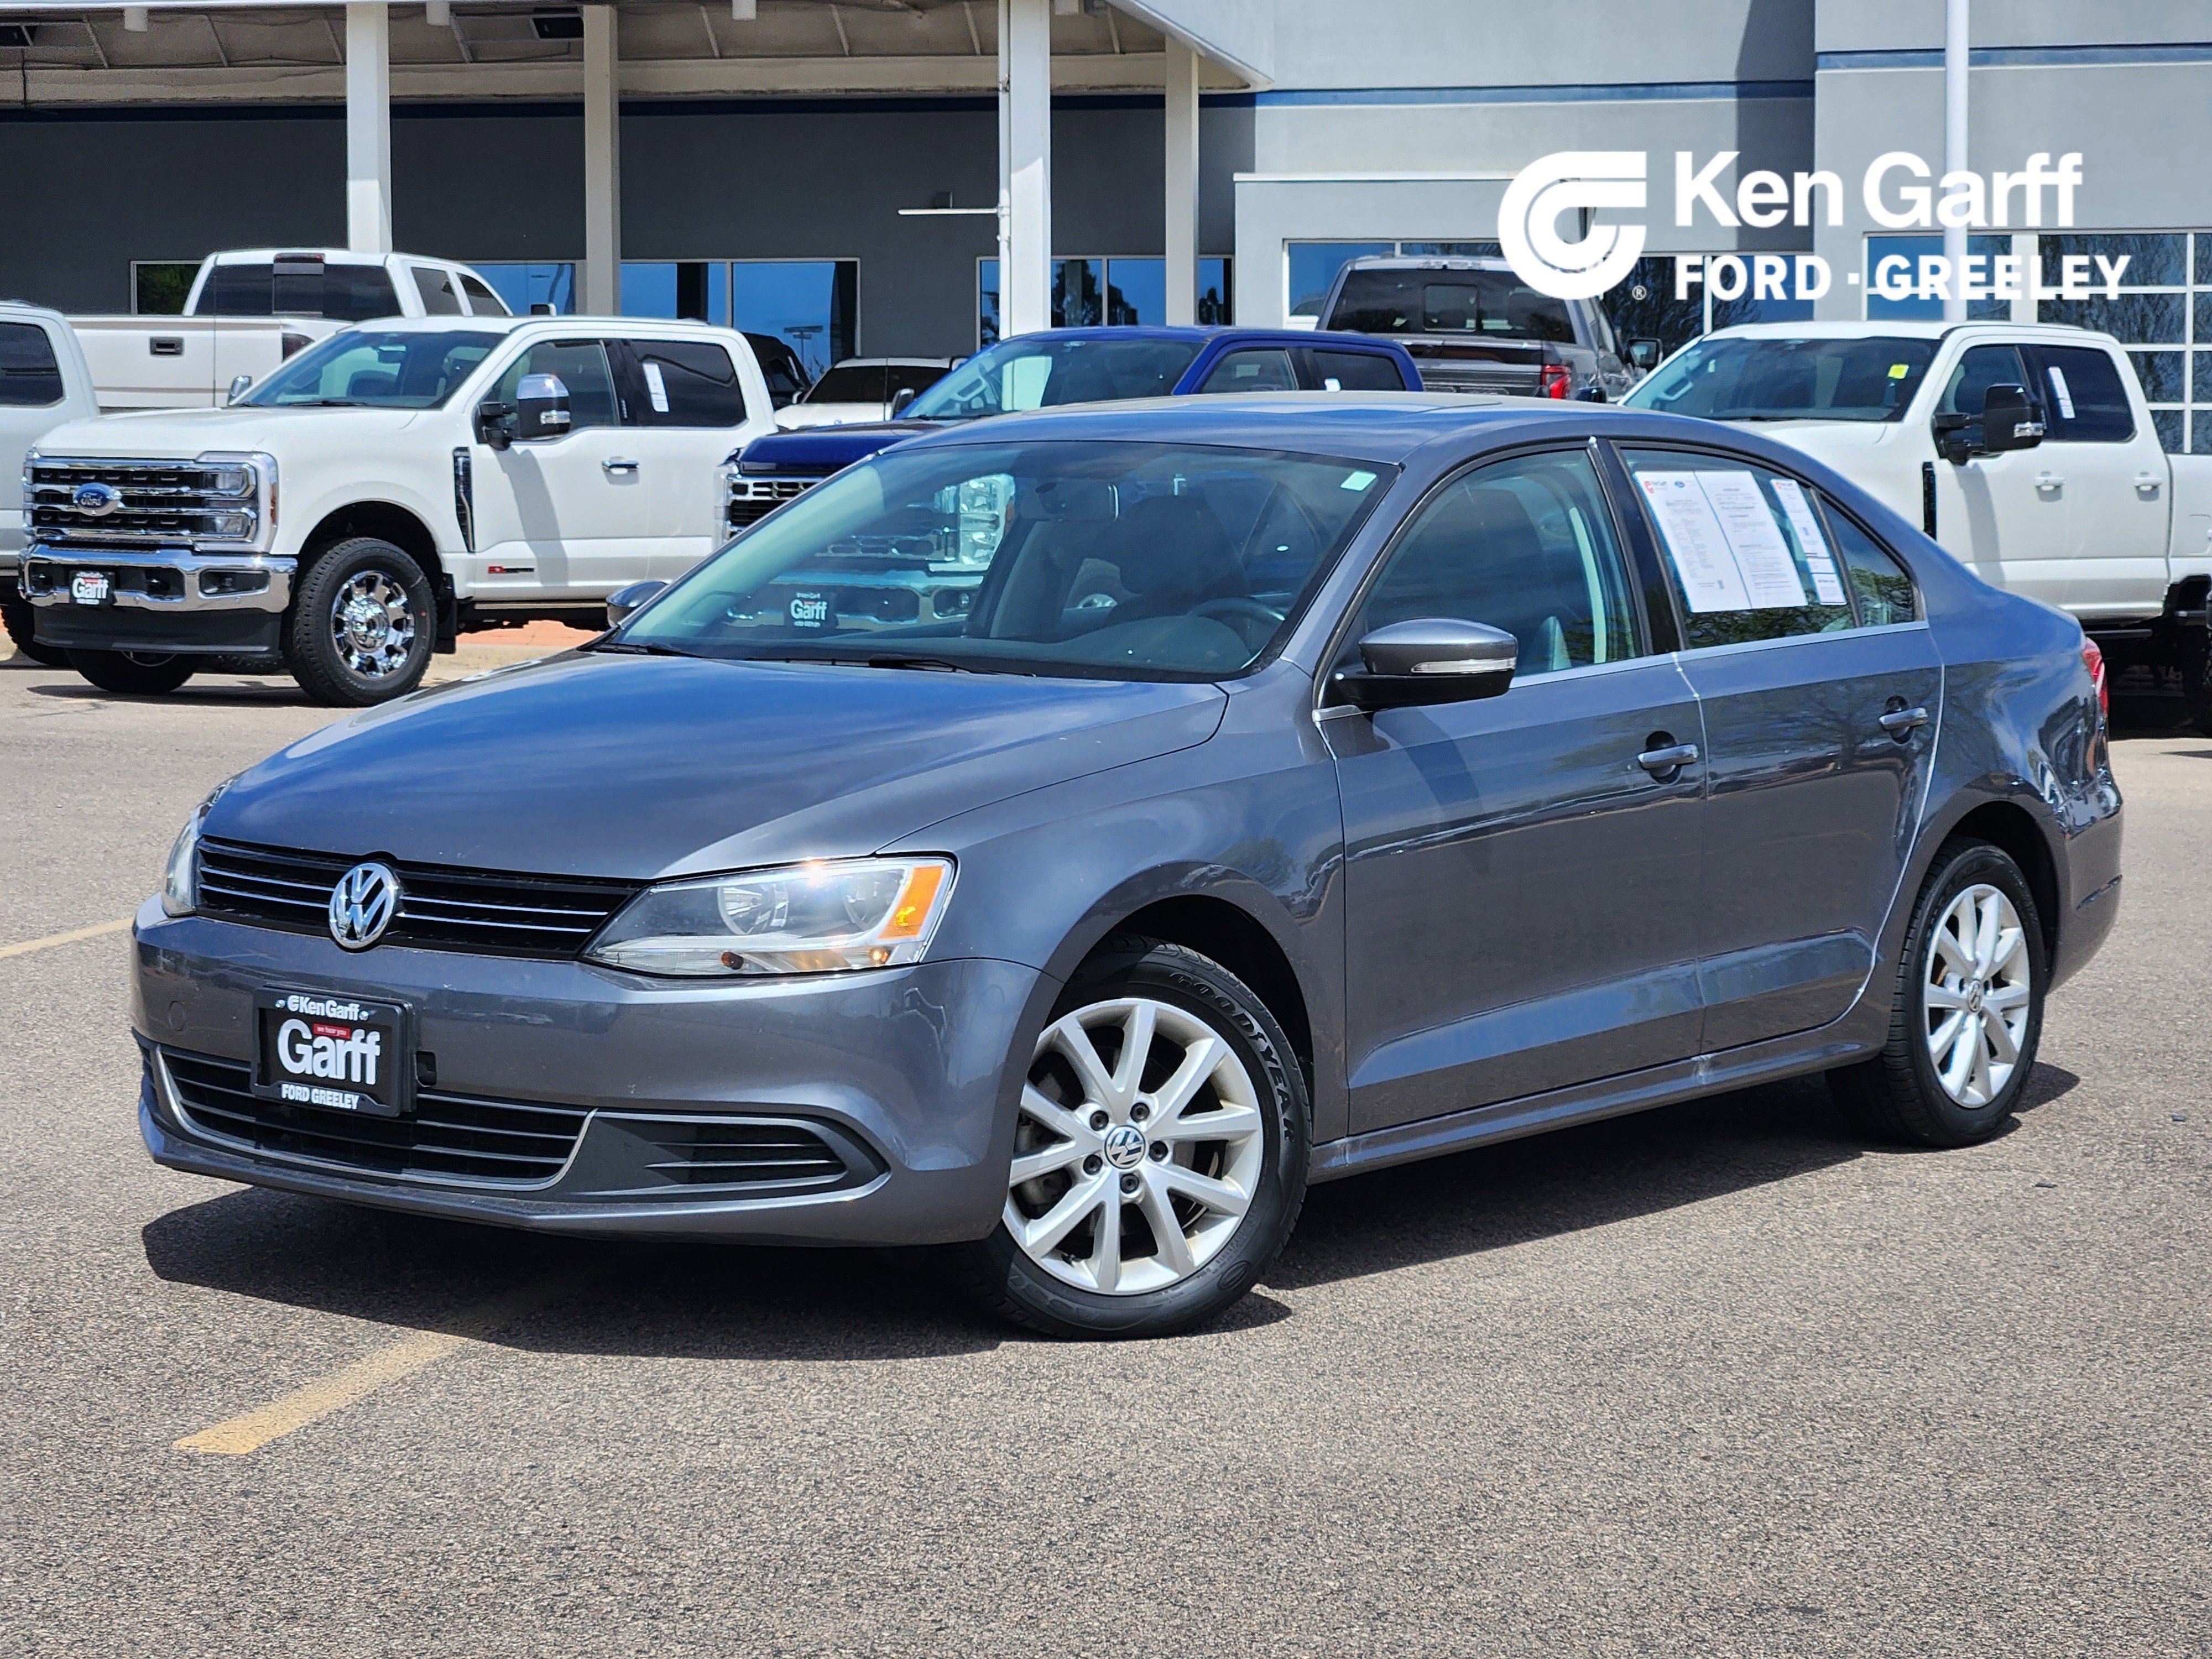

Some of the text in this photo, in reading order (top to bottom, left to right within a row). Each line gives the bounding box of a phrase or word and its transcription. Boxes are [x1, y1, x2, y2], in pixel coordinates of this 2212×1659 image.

[80, 492, 103, 506] Ford
[299, 996, 360, 1021] Ken Garff
[278, 1018, 382, 1086] Garff
[1168, 972, 1296, 1144] GOODYEAR
[281, 1083, 359, 1110] FORD GREELEY
